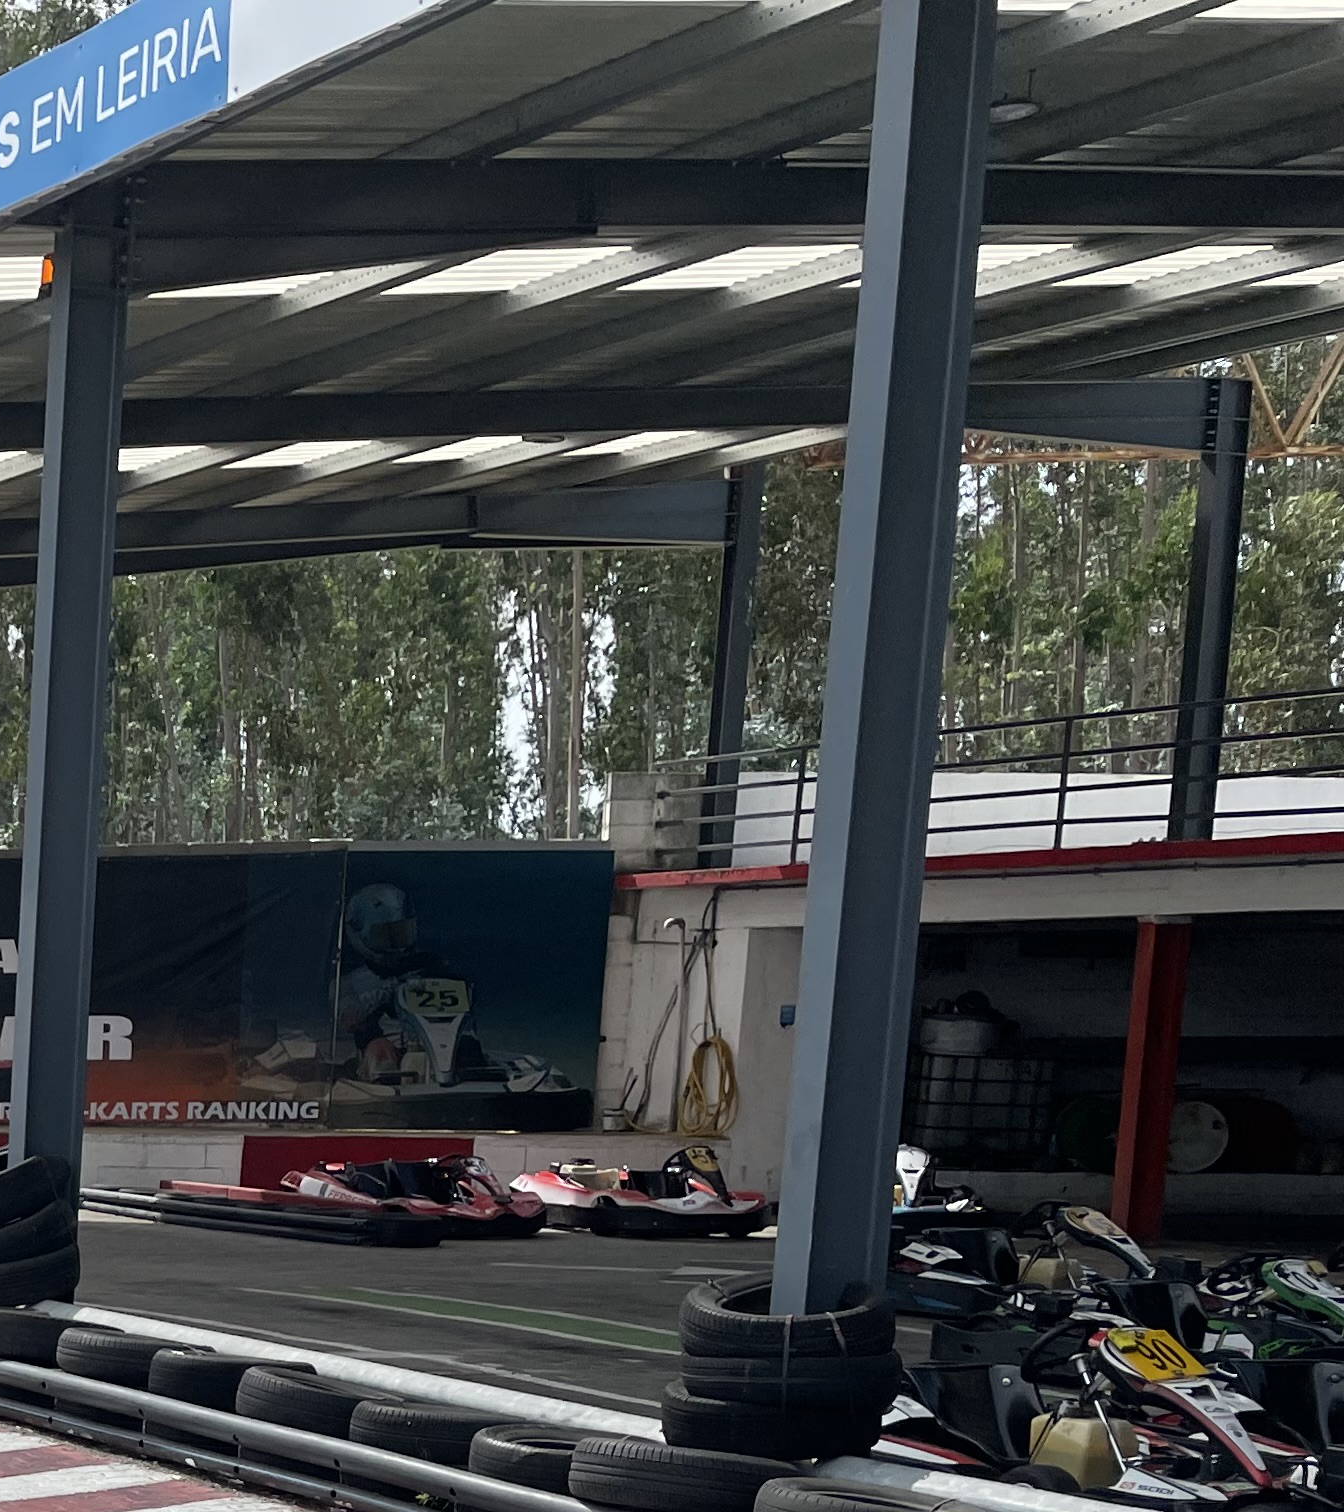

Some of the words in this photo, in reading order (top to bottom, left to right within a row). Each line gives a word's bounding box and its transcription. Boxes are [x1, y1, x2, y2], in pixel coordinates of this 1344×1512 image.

[31, 76, 85, 155] EM
[96, 6, 222, 123] LEIRIA
[416, 989, 460, 1008] 25
[186, 1101, 320, 1120] RANKING
[1134, 1338, 1187, 1371] 90
